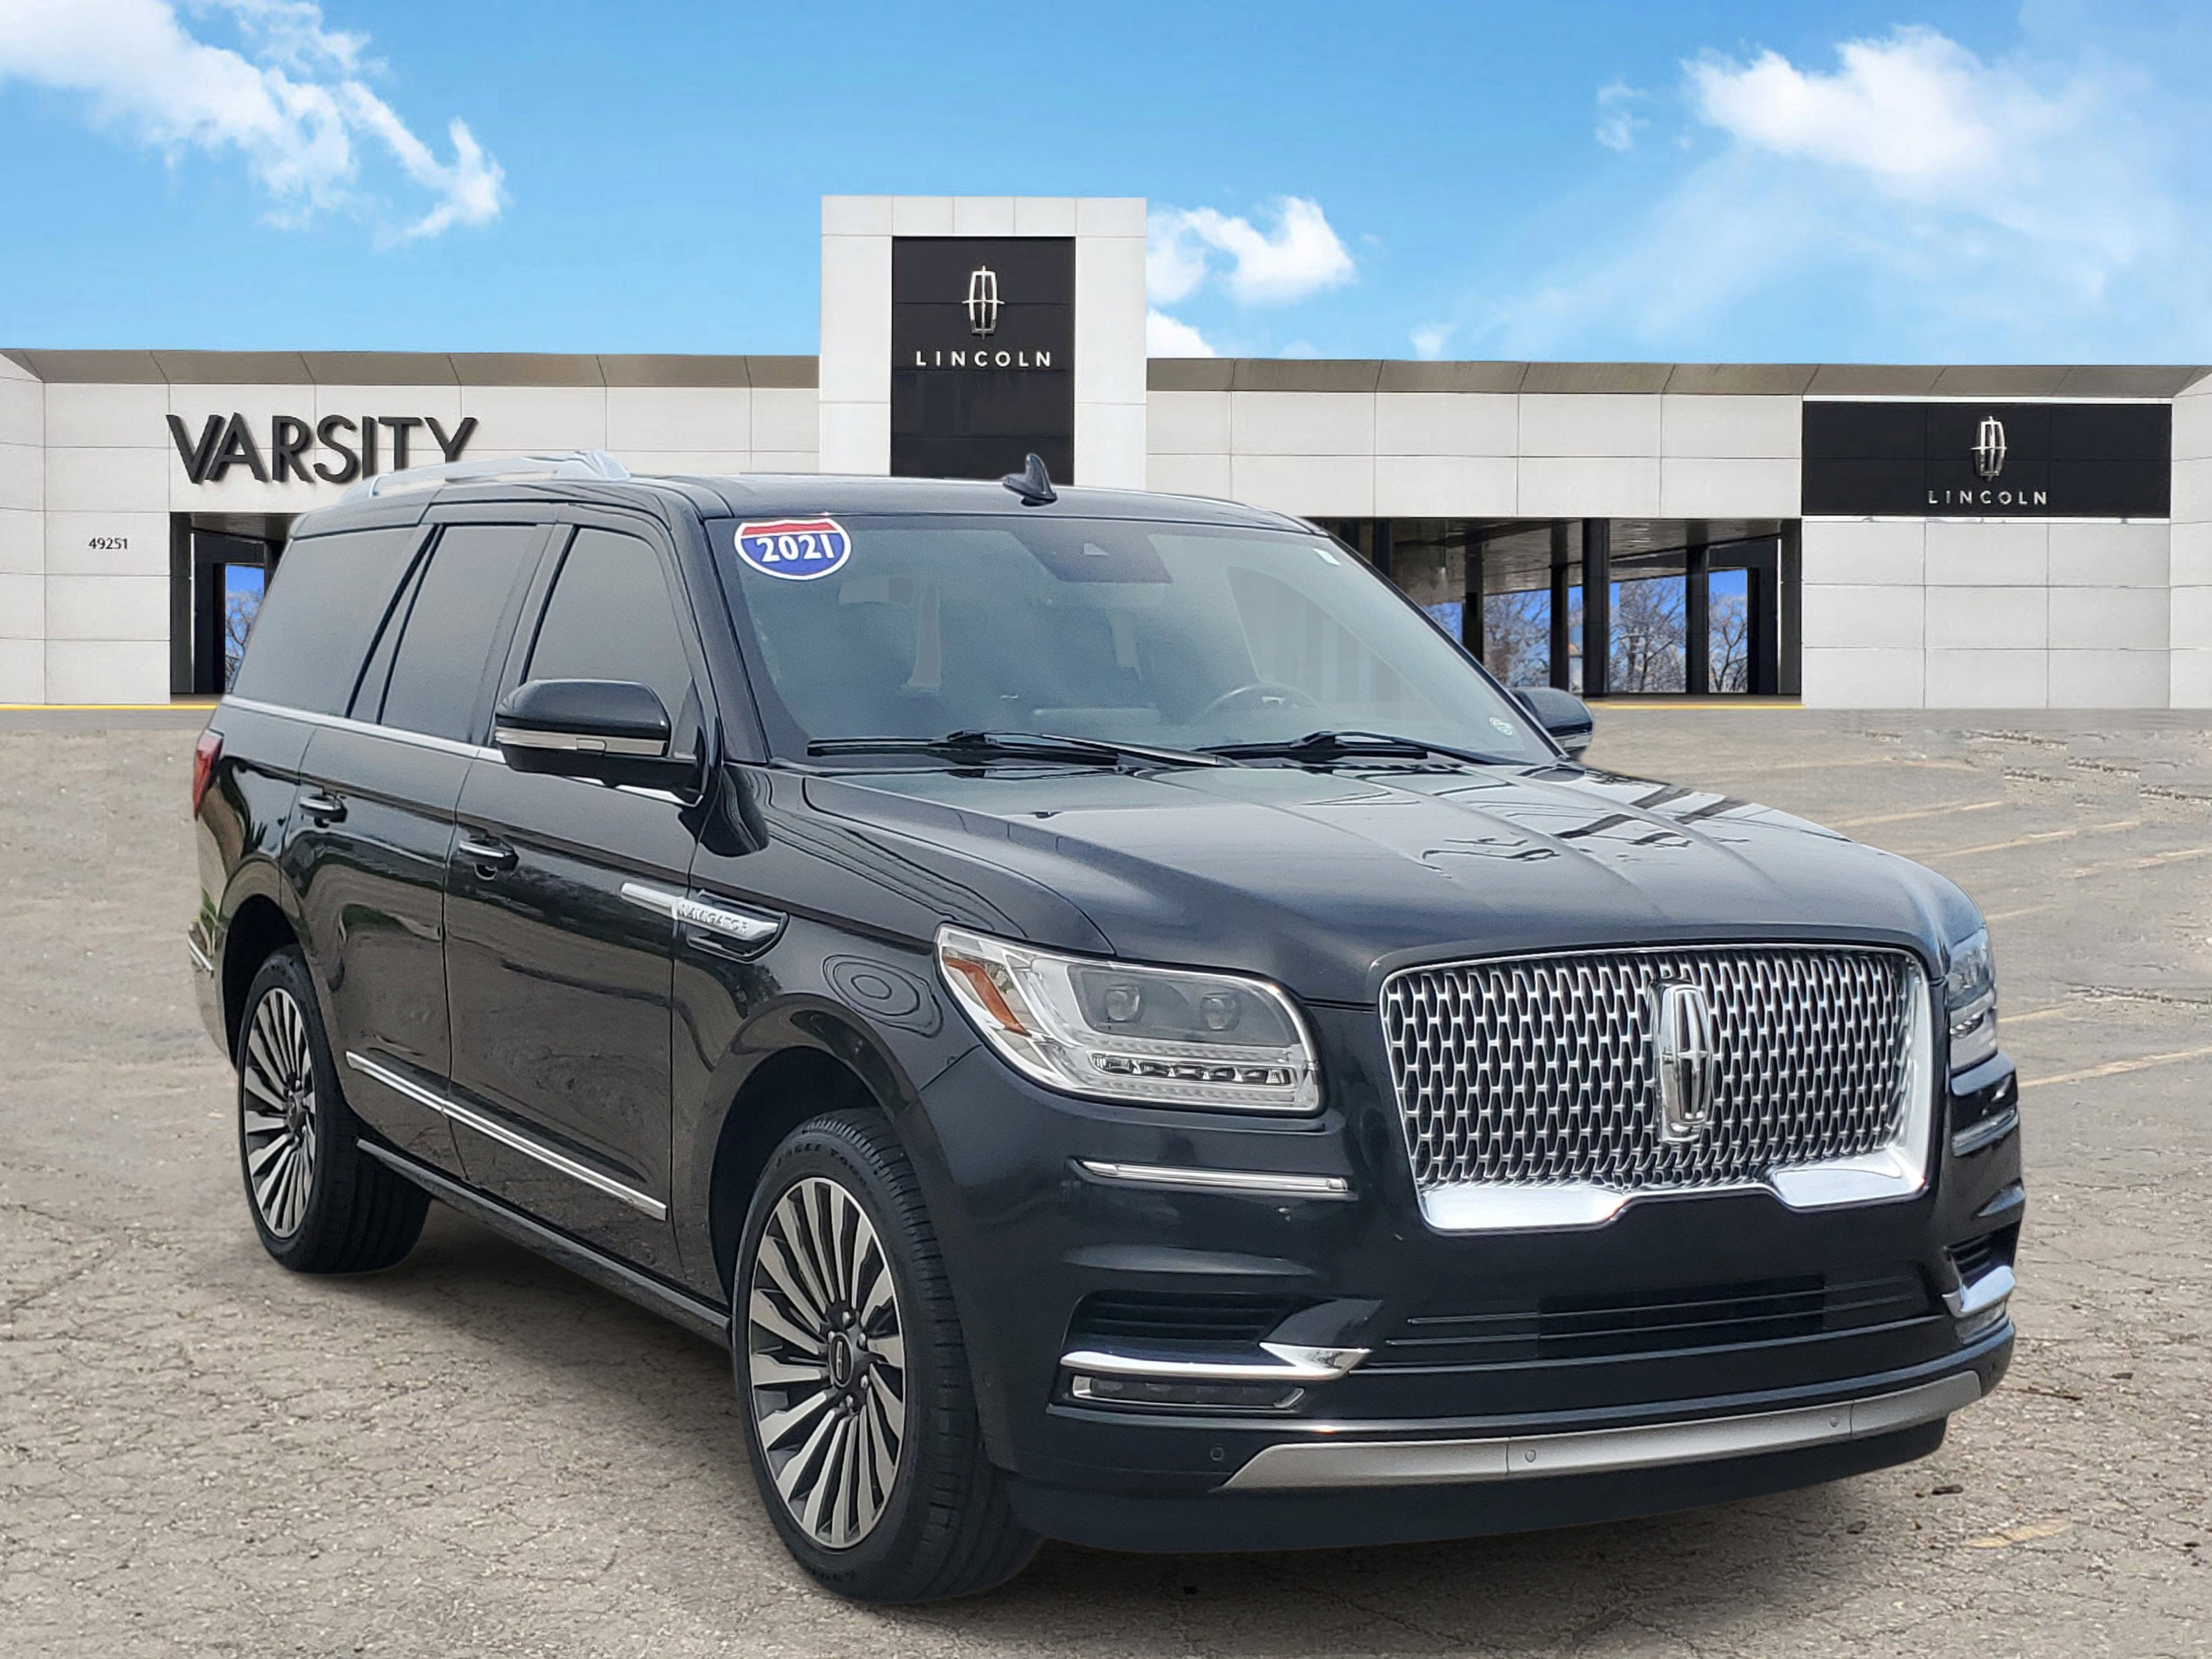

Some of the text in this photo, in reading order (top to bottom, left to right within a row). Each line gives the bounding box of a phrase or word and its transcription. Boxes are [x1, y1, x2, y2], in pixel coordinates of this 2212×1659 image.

[916, 350, 1051, 367] LINCOLN
[166, 411, 478, 484] VARSITY
[1928, 490, 2047, 505] LINCOLN
[88, 537, 128, 550] 49251
[756, 534, 835, 563] 2021
